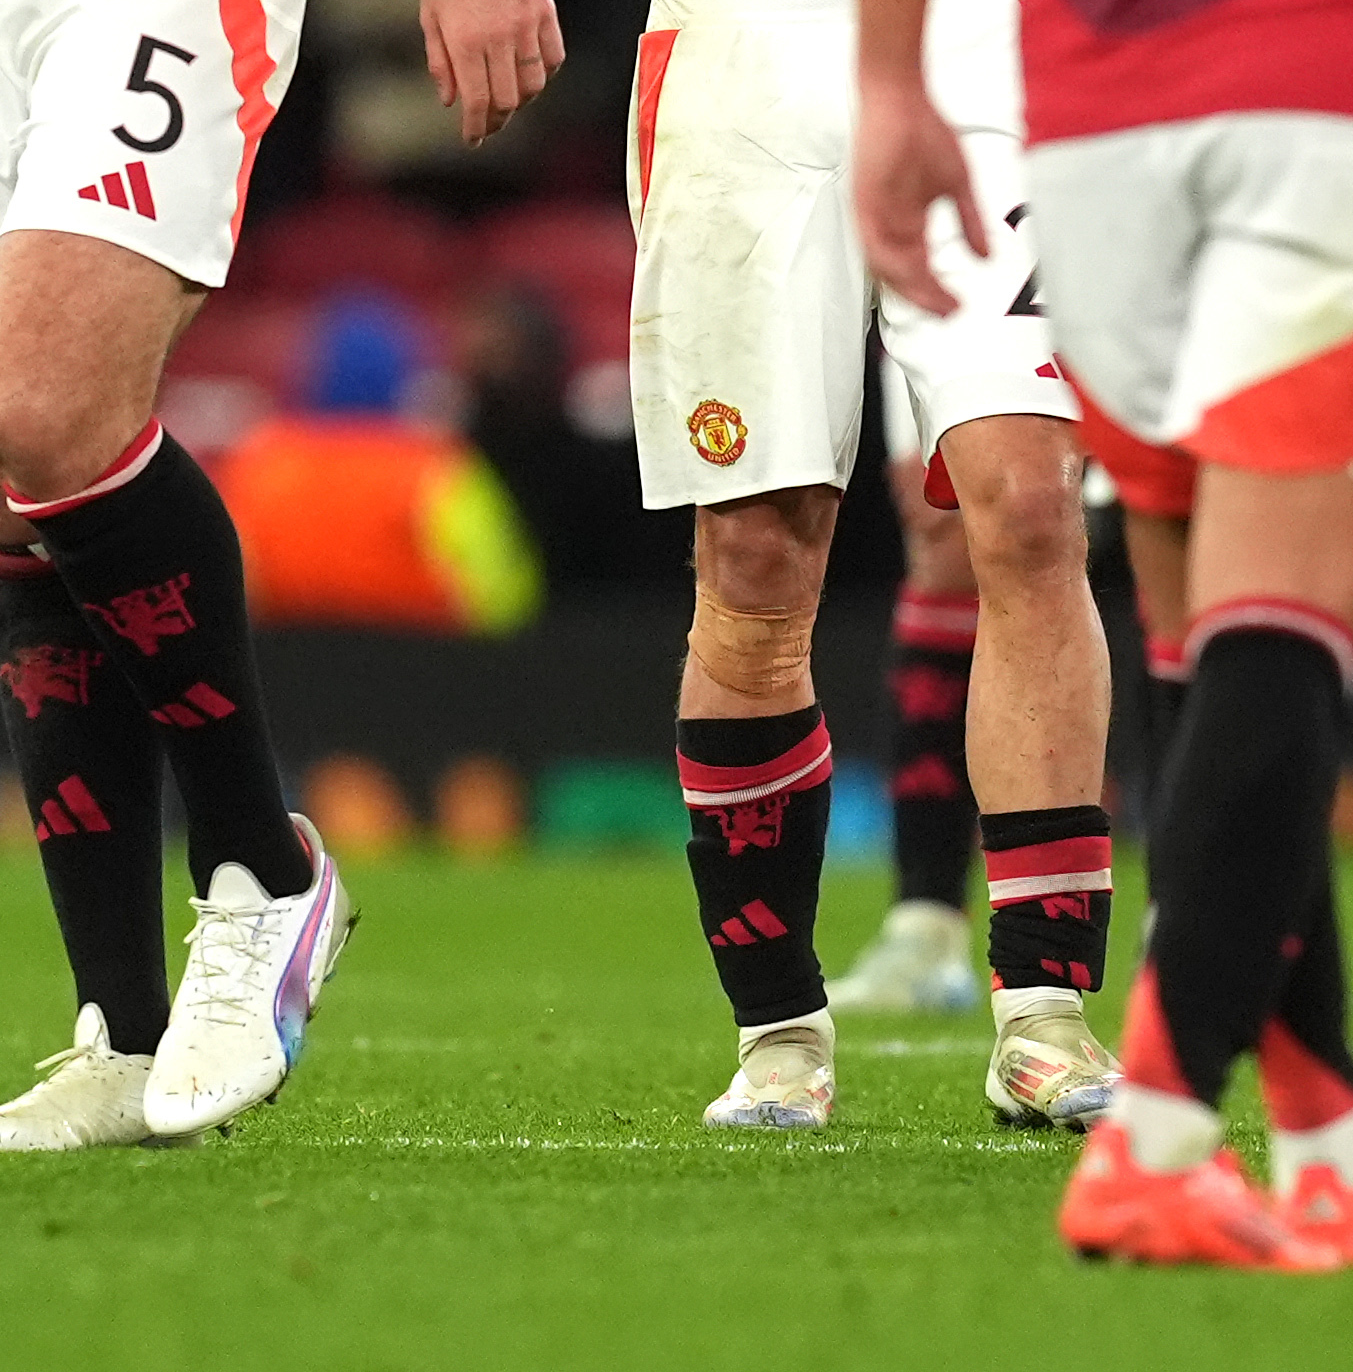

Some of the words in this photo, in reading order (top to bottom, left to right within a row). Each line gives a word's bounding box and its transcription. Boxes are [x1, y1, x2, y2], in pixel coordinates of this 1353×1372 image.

[111, 34, 197, 154] 5
[690, 403, 738, 430] MANCHESTER
[707, 447, 740, 462] UNITED
